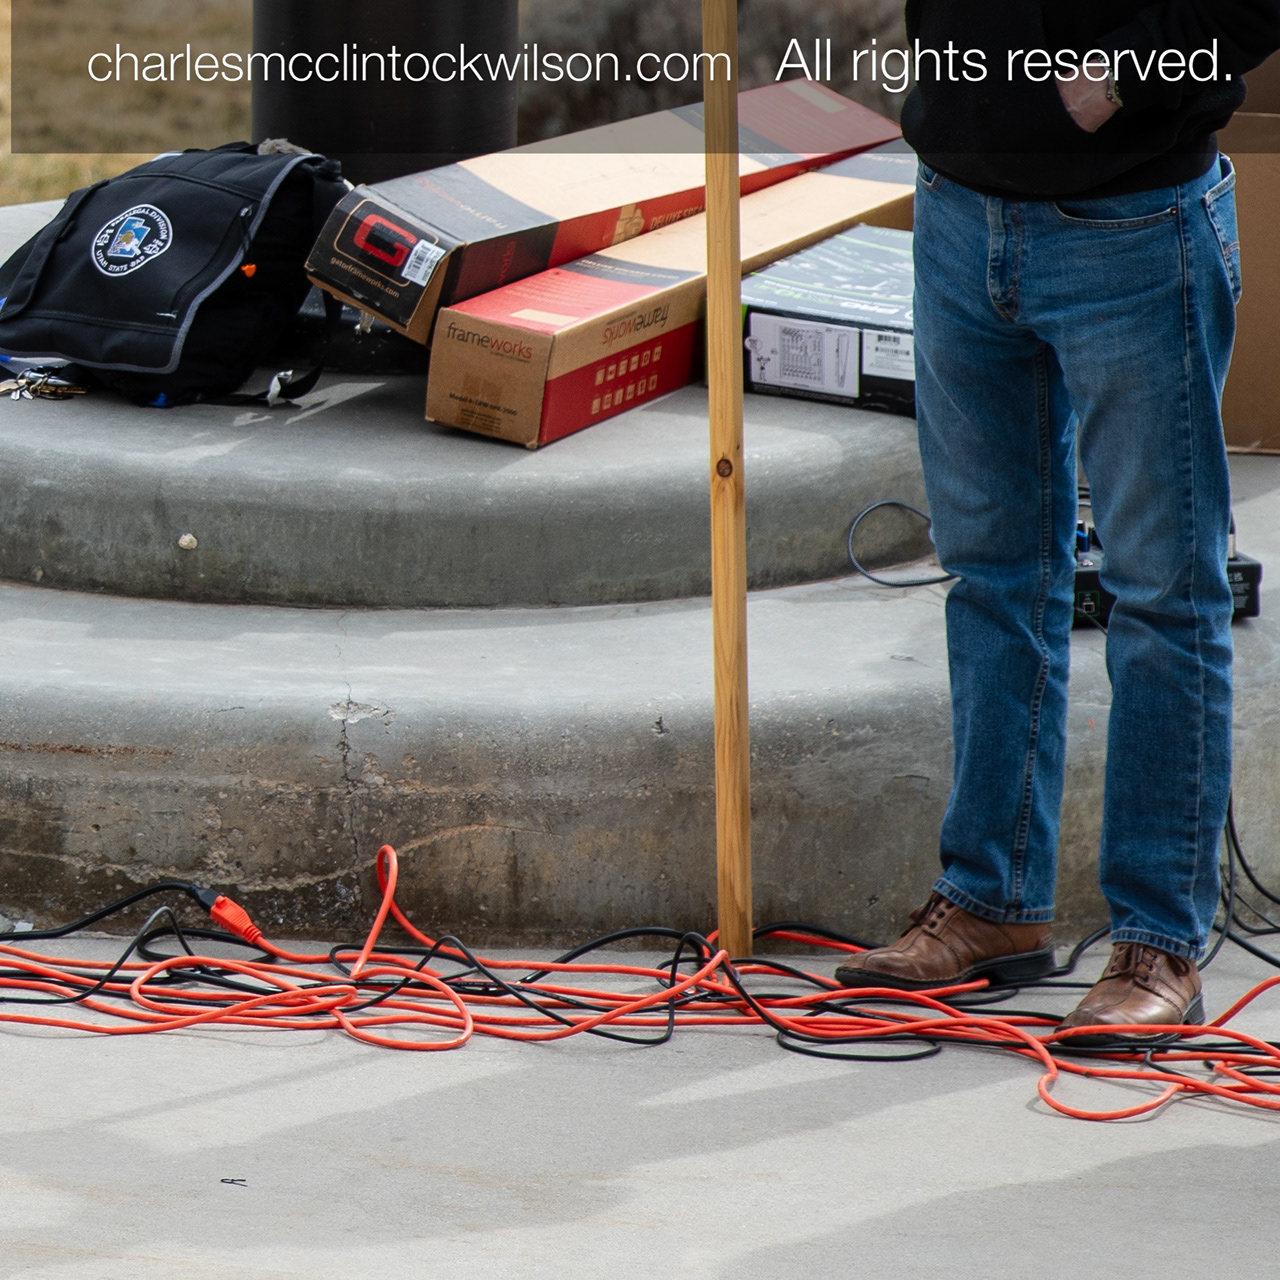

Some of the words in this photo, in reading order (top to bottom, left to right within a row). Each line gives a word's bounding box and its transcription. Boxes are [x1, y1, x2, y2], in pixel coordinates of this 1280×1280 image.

[149, 210, 168, 240] DIVISION
[95, 249, 108, 268] UTAH
[108, 264, 128, 272] STATE
[130, 255, 145, 268] BAR
[330, 256, 400, 299] gatorframeworks.com
[447, 321, 533, 359] frameworks
[603, 304, 671, 347] frameworks
